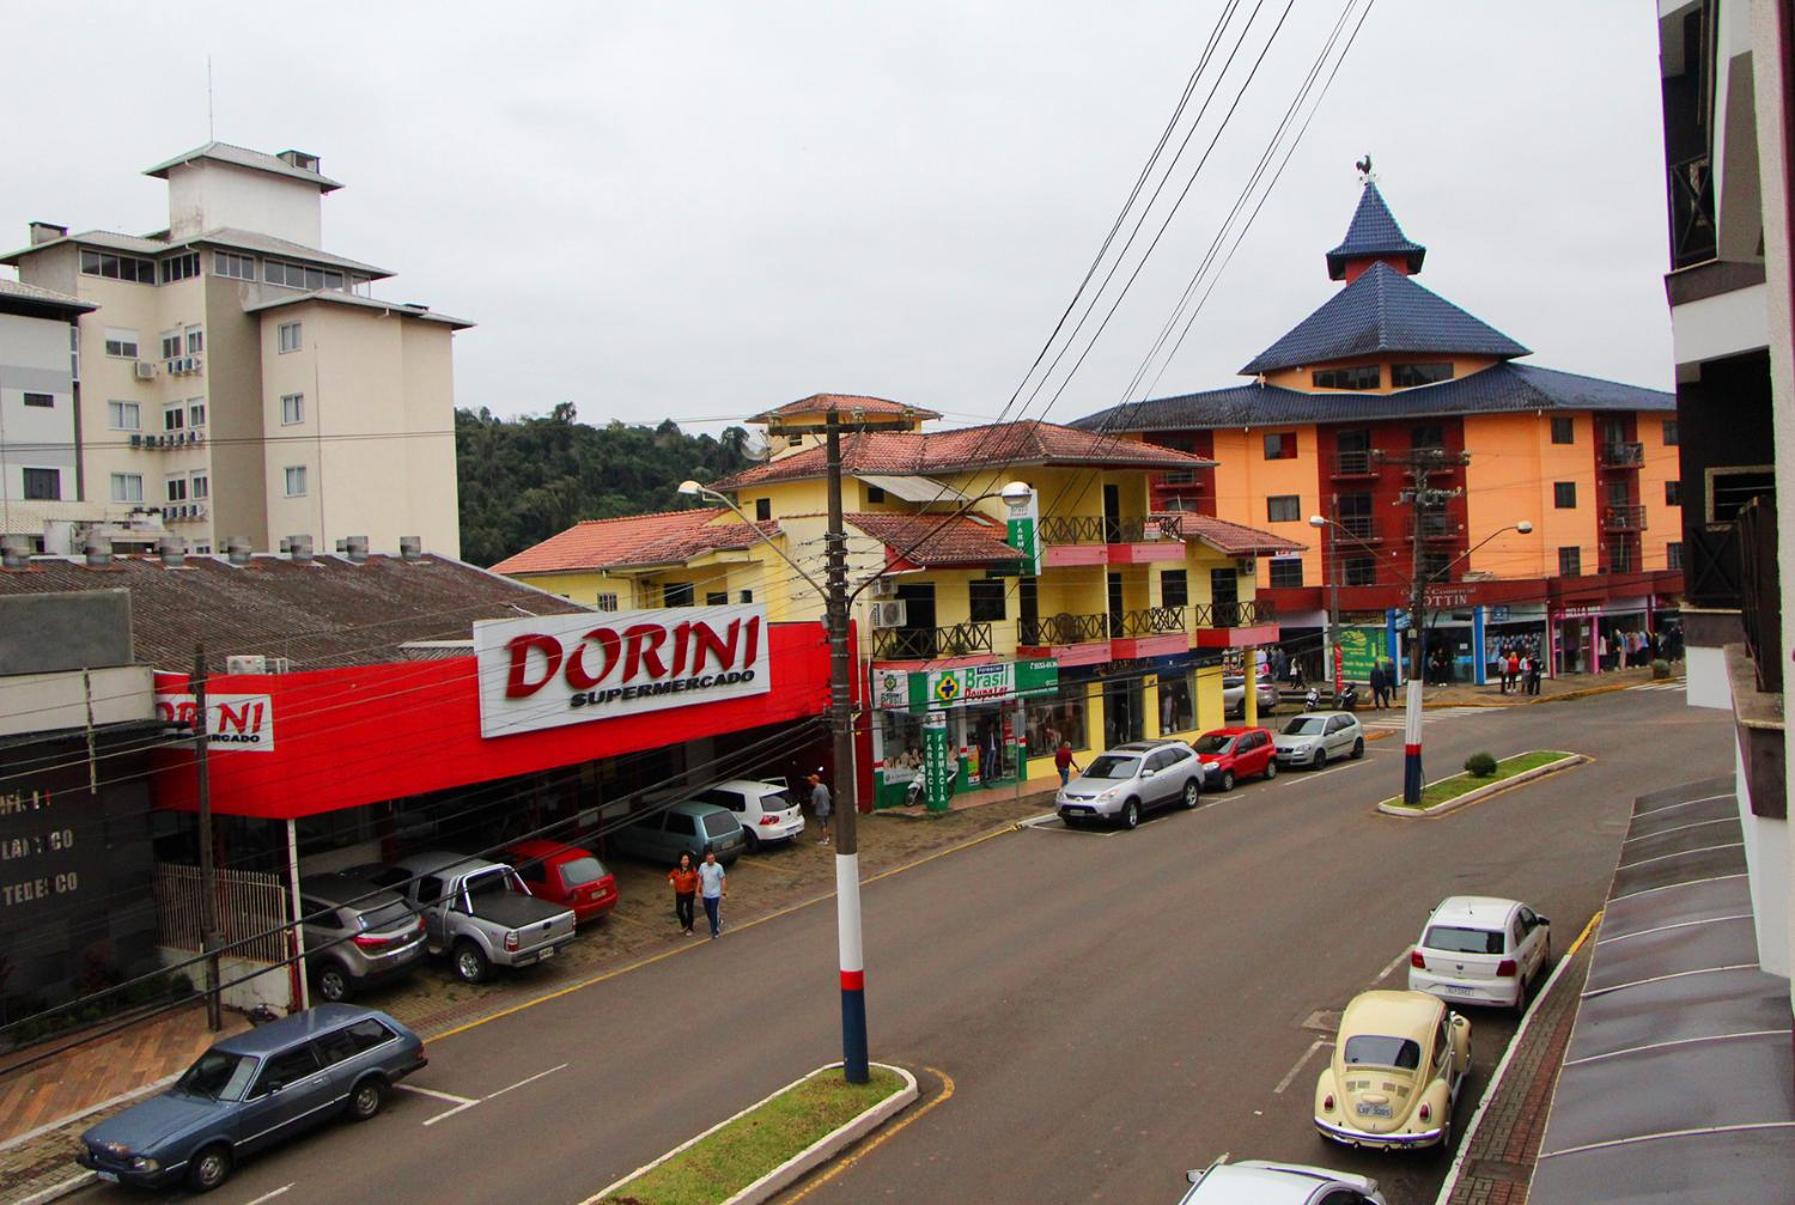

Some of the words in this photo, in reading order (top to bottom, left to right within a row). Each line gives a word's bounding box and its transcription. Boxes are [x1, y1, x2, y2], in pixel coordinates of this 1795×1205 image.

[505, 615, 760, 698] DORINI
[570, 670, 755, 707] SUPERMERCADO
[965, 663, 1009, 688] Brasil
[926, 734, 934, 803] FARMACIA
[937, 734, 945, 802] FARMACIA
